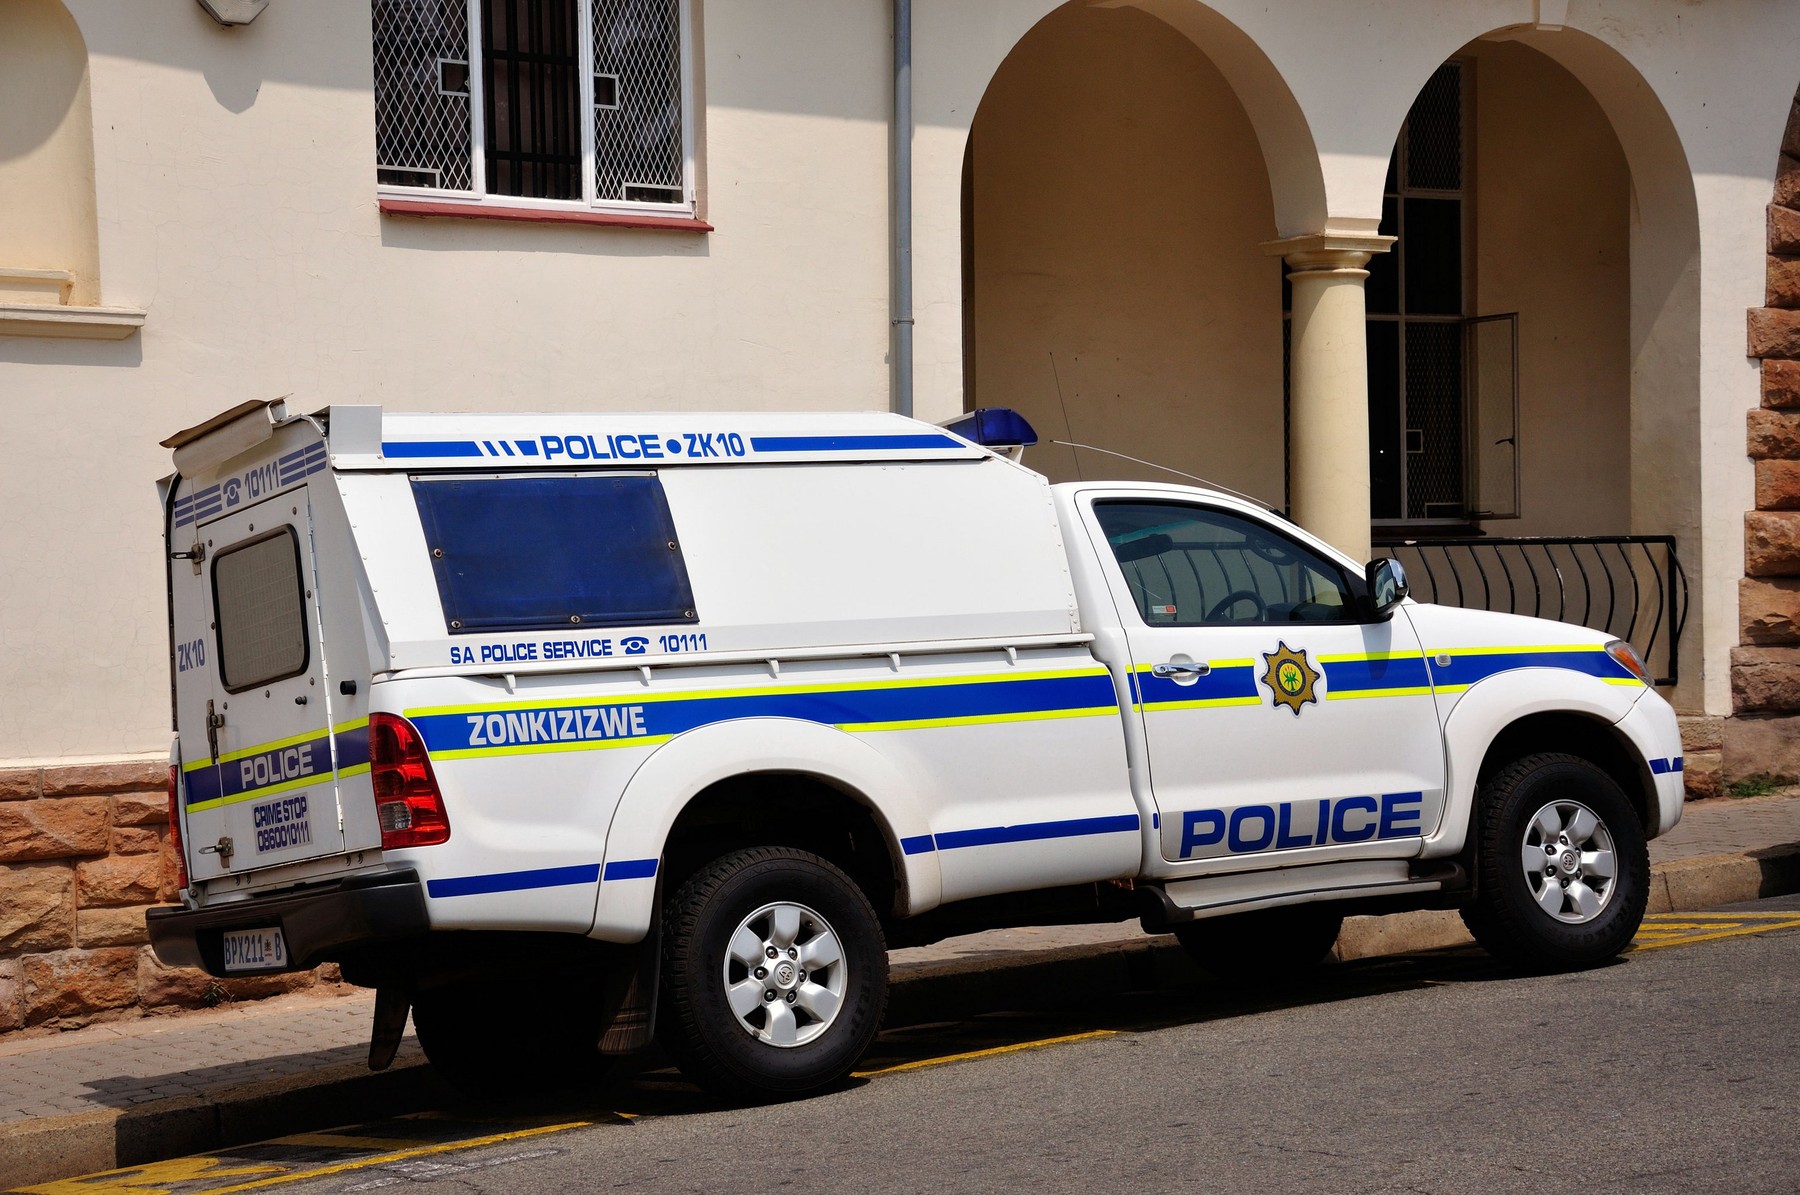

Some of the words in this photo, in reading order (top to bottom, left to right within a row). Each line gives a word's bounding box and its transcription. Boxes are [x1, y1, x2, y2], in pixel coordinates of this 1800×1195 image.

[540, 434, 665, 460] POLICE
[683, 432, 746, 458] ZK10
[244, 461, 280, 499] 10111
[177, 638, 206, 672] ZK10
[450, 646, 475, 665] SA
[481, 643, 538, 663] POLICE
[542, 639, 613, 660] SERVICE
[658, 633, 708, 653] 10111
[467, 706, 647, 746] ZONKIZIZWE
[240, 744, 314, 789] POLICE
[253, 802, 283, 828] CRIME
[282, 796, 308, 822] STOP
[1179, 791, 1423, 859] POLICE
[257, 820, 310, 852] 0860010111
